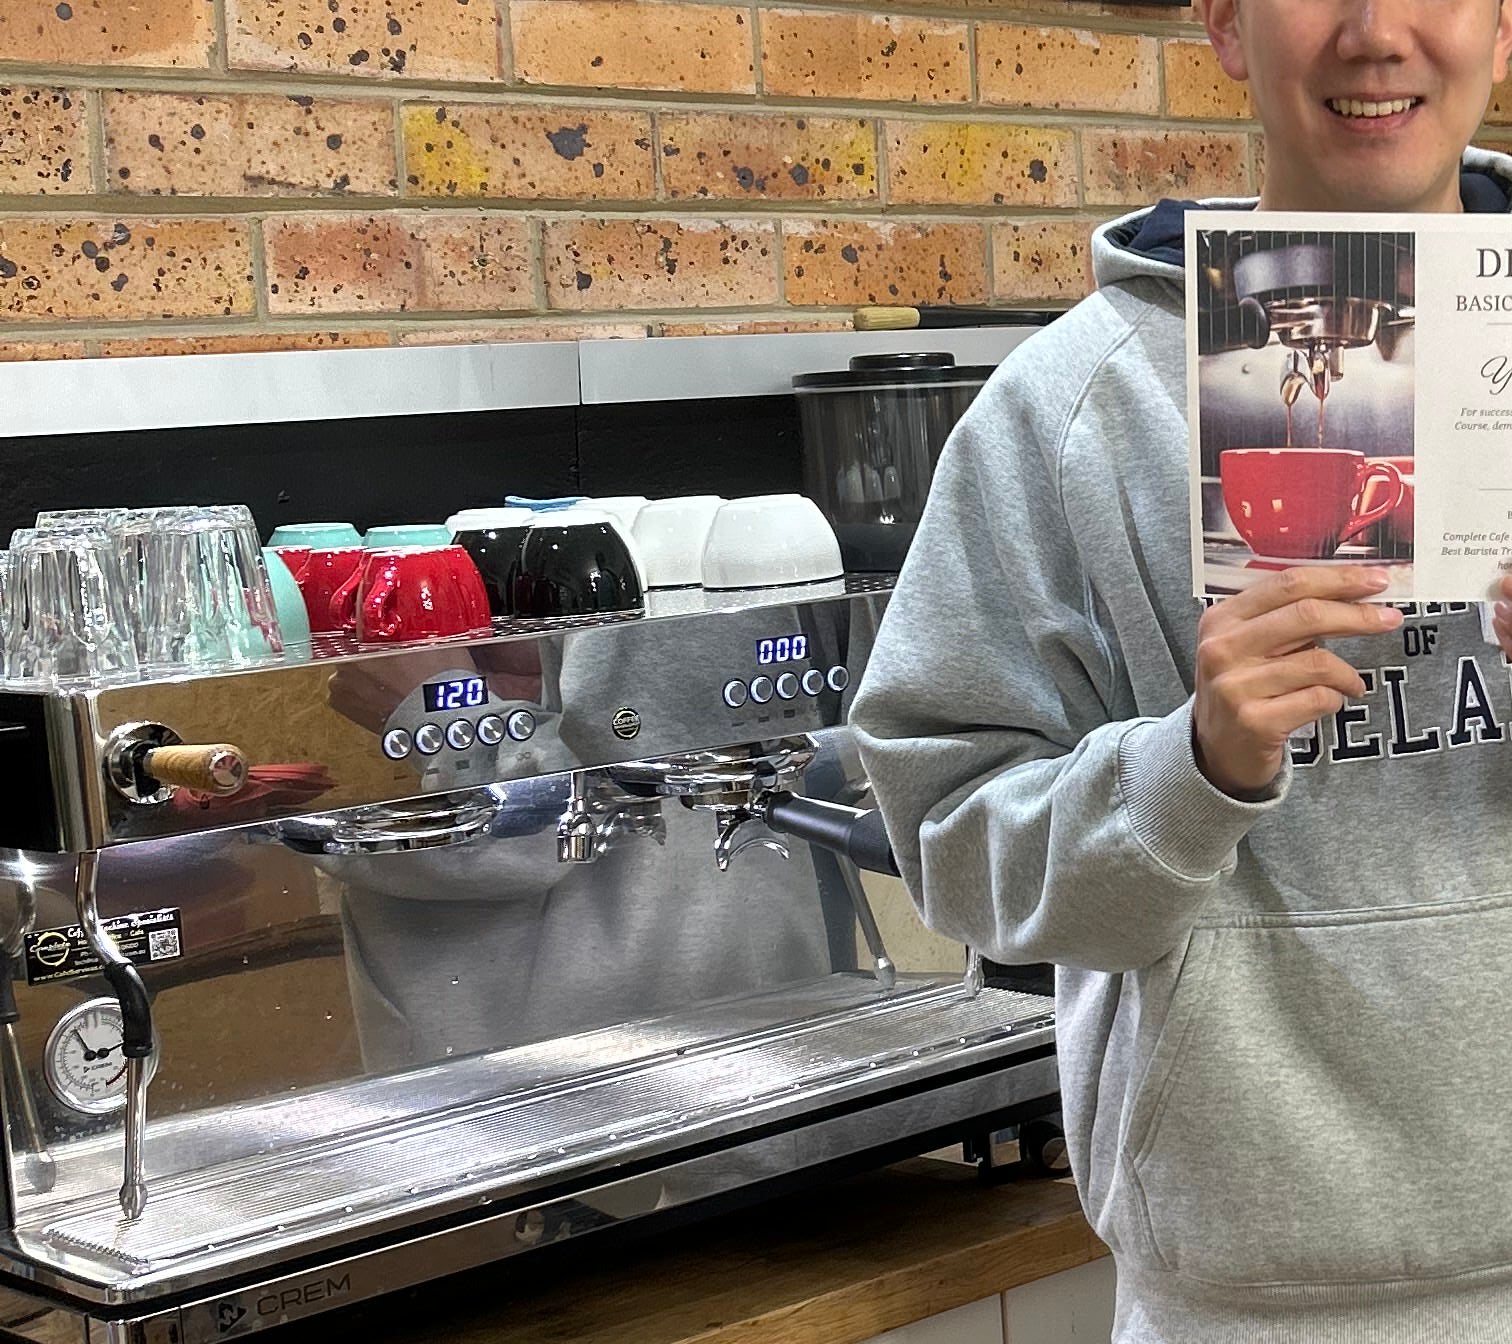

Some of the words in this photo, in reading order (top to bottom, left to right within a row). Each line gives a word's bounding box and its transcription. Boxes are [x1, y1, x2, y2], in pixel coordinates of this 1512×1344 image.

[1456, 294, 1512, 312] BASIC
[1461, 408, 1477, 417] For
[1454, 422, 1489, 431] Course,
[1443, 533, 1487, 543] Complete
[1489, 533, 1509, 543] Cafe
[1441, 547, 1462, 556] Best
[1464, 546, 1498, 555] Barista
[1402, 624, 1438, 656] OF
[759, 635, 807, 665] 000
[436, 678, 484, 708] 120
[257, 1273, 350, 1316] CREM
